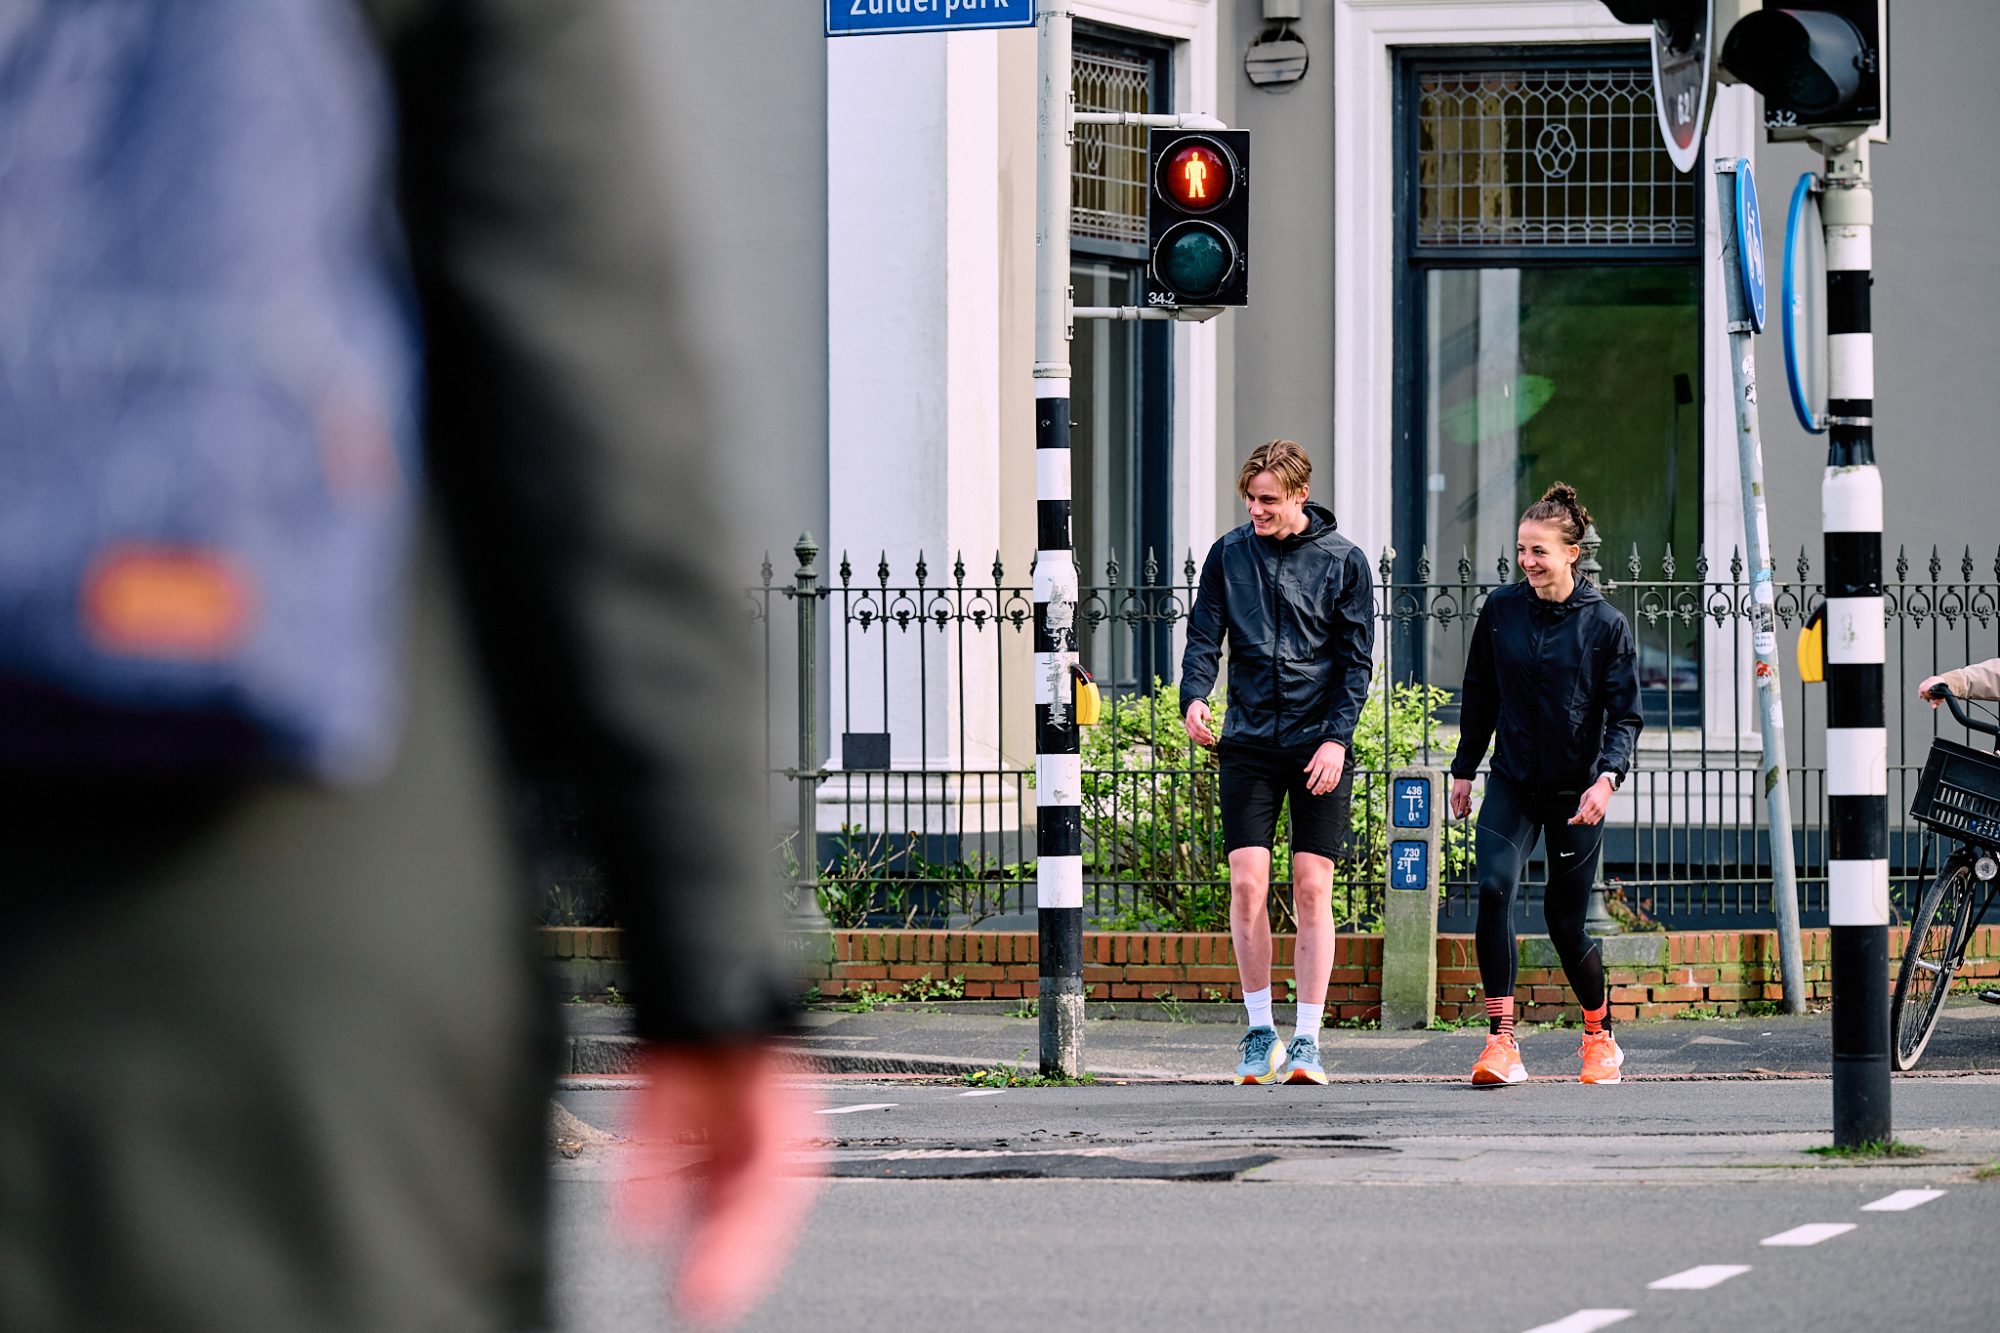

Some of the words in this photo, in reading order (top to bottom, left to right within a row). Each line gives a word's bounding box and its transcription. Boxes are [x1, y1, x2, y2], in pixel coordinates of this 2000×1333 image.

[1406, 786, 1422, 796] 436
[1417, 799, 1424, 808] 2
[1404, 848, 1420, 857] 730
